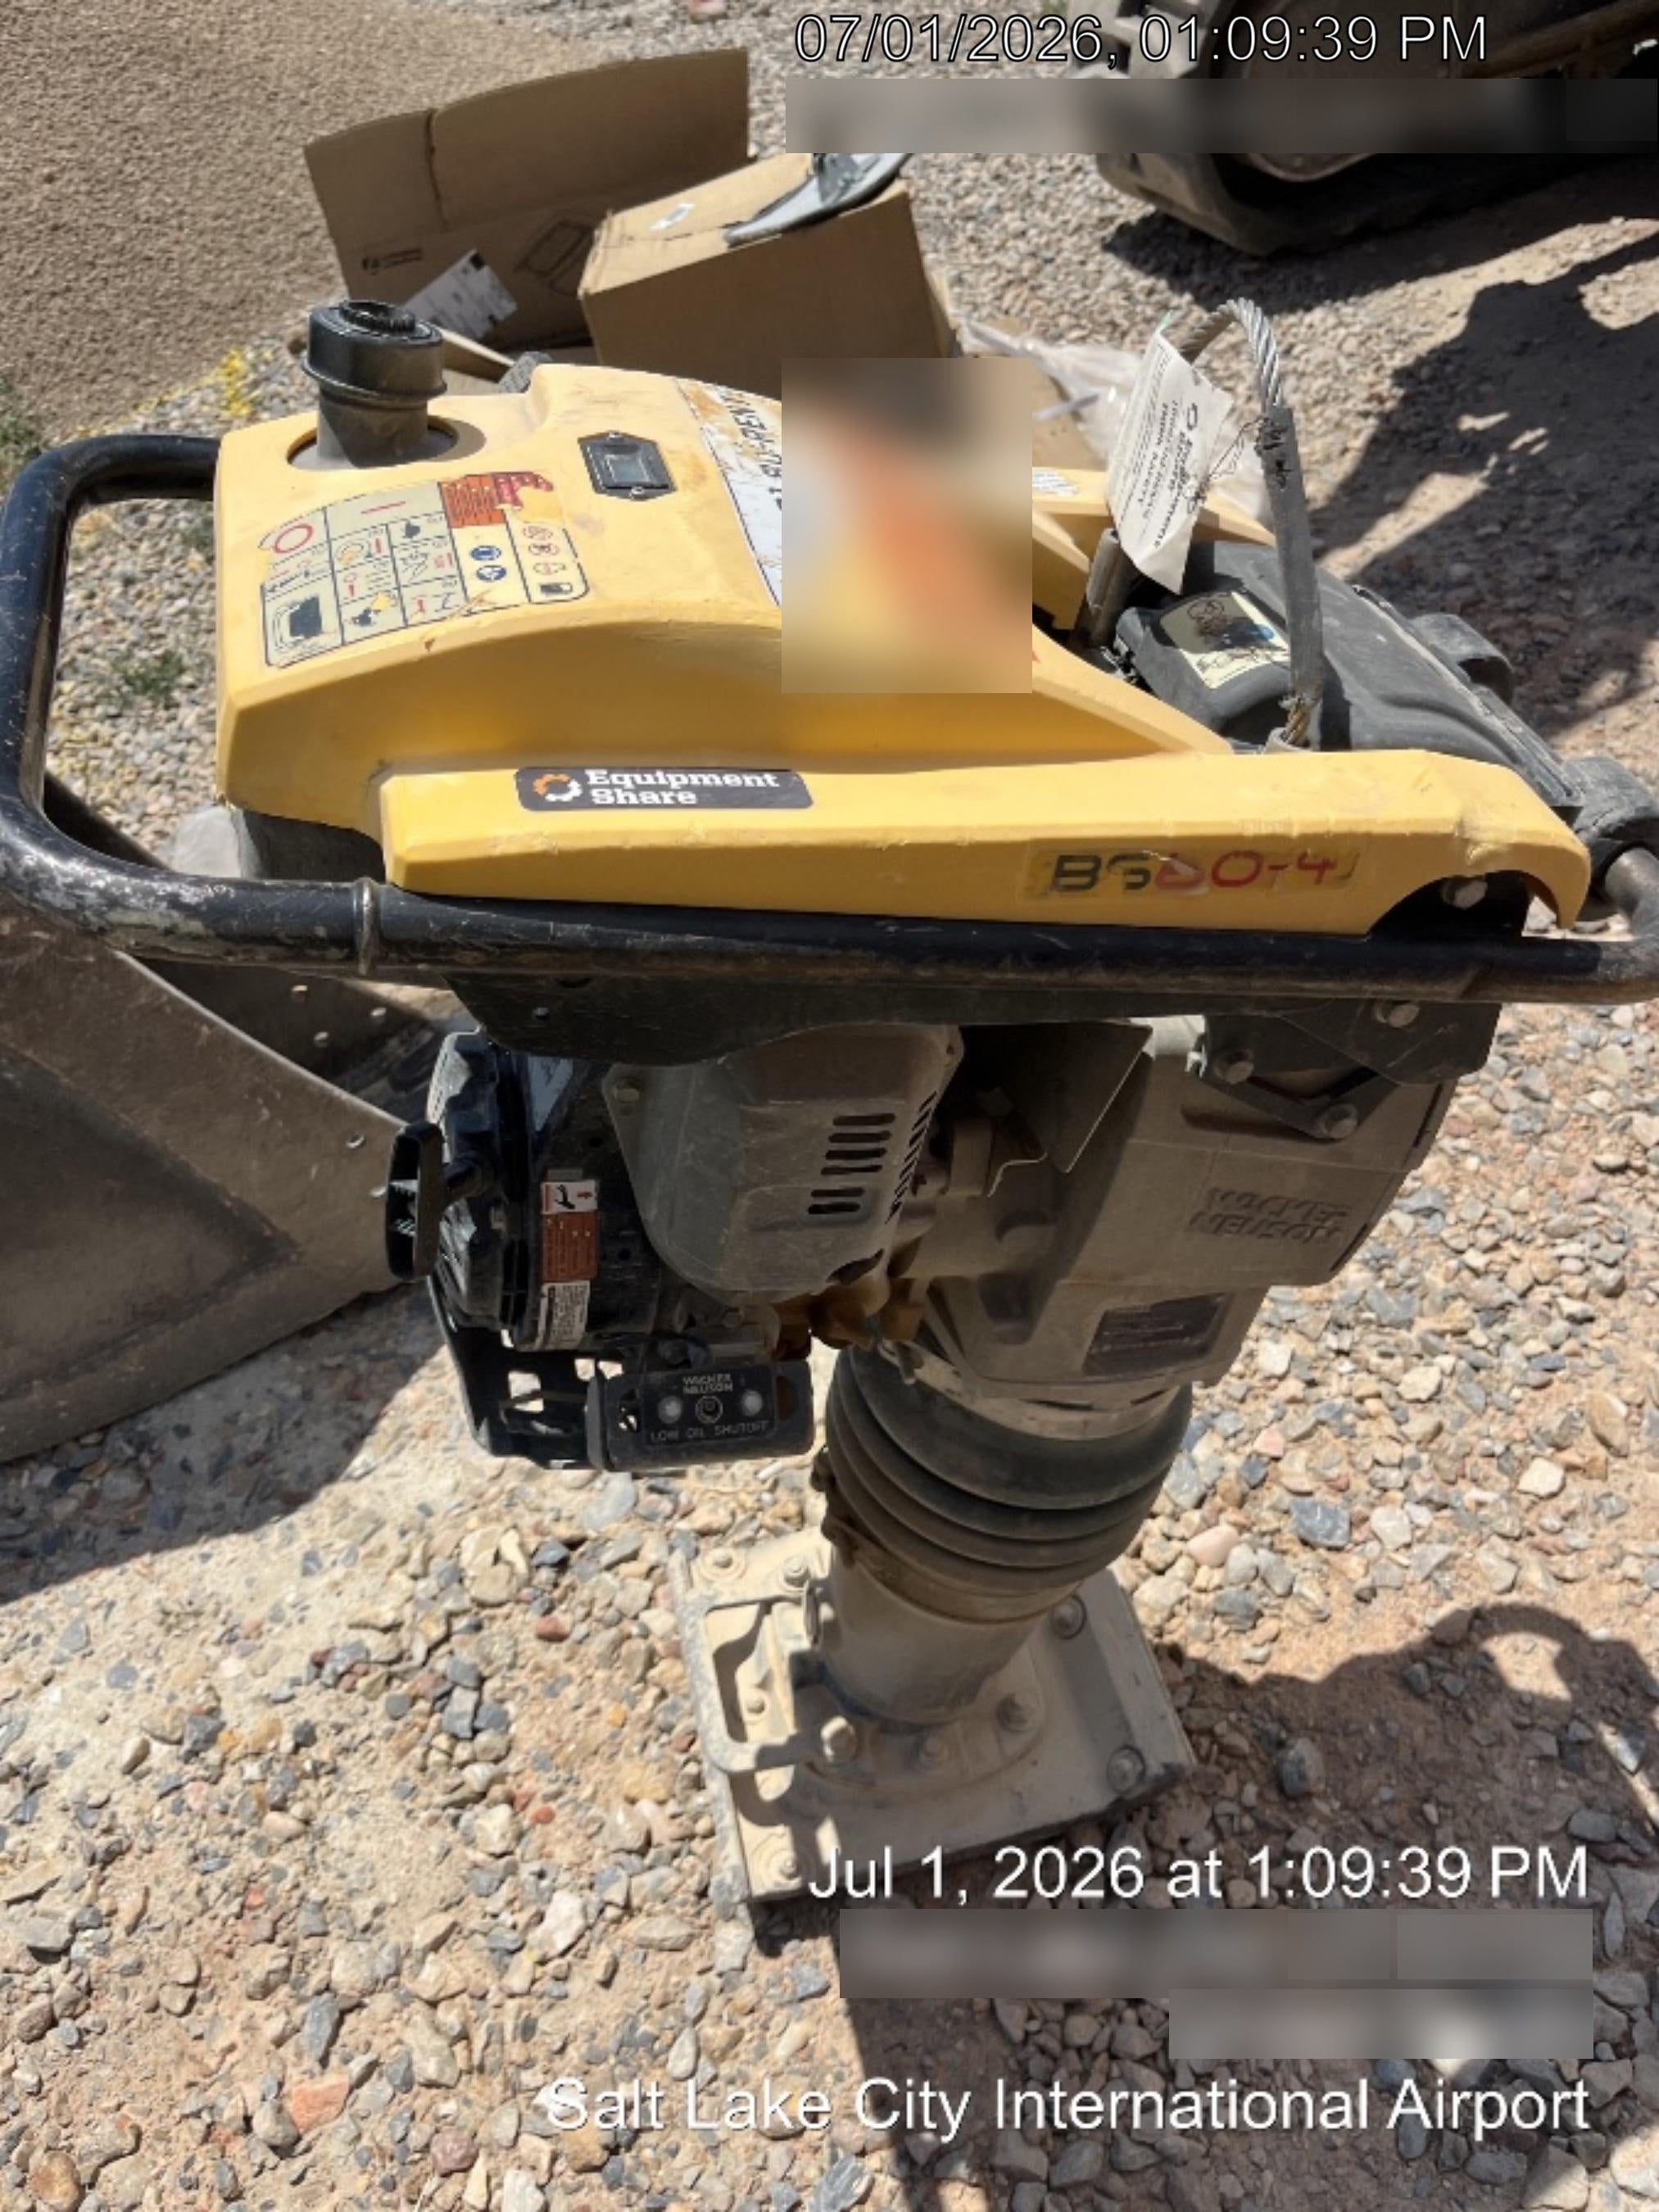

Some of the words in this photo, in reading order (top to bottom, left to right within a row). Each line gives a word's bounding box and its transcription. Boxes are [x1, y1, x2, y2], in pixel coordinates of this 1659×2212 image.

[584, 768, 779, 789] Equipment
[590, 787, 696, 805] Share
[650, 1429, 679, 1442] LOW
[687, 1426, 705, 1439] OIL
